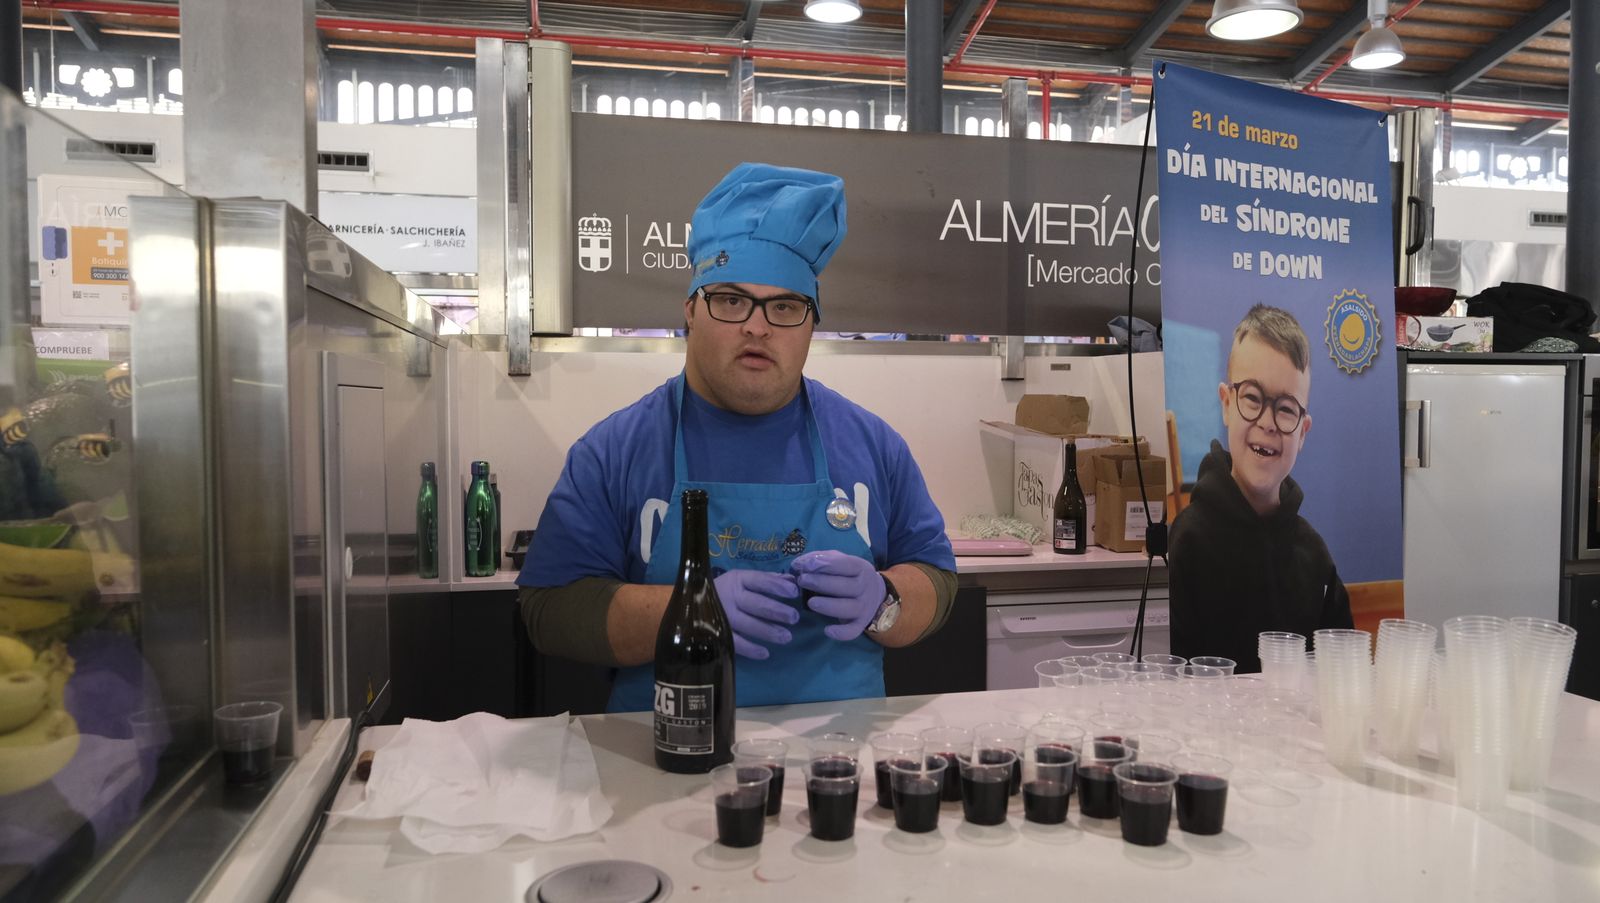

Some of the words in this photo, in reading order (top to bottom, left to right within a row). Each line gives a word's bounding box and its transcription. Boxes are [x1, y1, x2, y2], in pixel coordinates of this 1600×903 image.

[1192, 111, 1212, 131] 21
[1218, 115, 1240, 139] de
[1245, 125, 1298, 150] marzo
[1167, 142, 1207, 178] DÍA
[1215, 157, 1378, 204] INTERNACIONAL
[328, 224, 385, 234] ARNICERÍA
[1201, 203, 1228, 224] DEL
[1236, 198, 1350, 244] SÍNDROME
[643, 252, 691, 269] CIUD
[1233, 252, 1253, 270] DE
[1260, 251, 1323, 280] DOWN
[1341, 304, 1368, 321] ASALSIDO
[35, 346, 93, 354] COMPRUEBE
